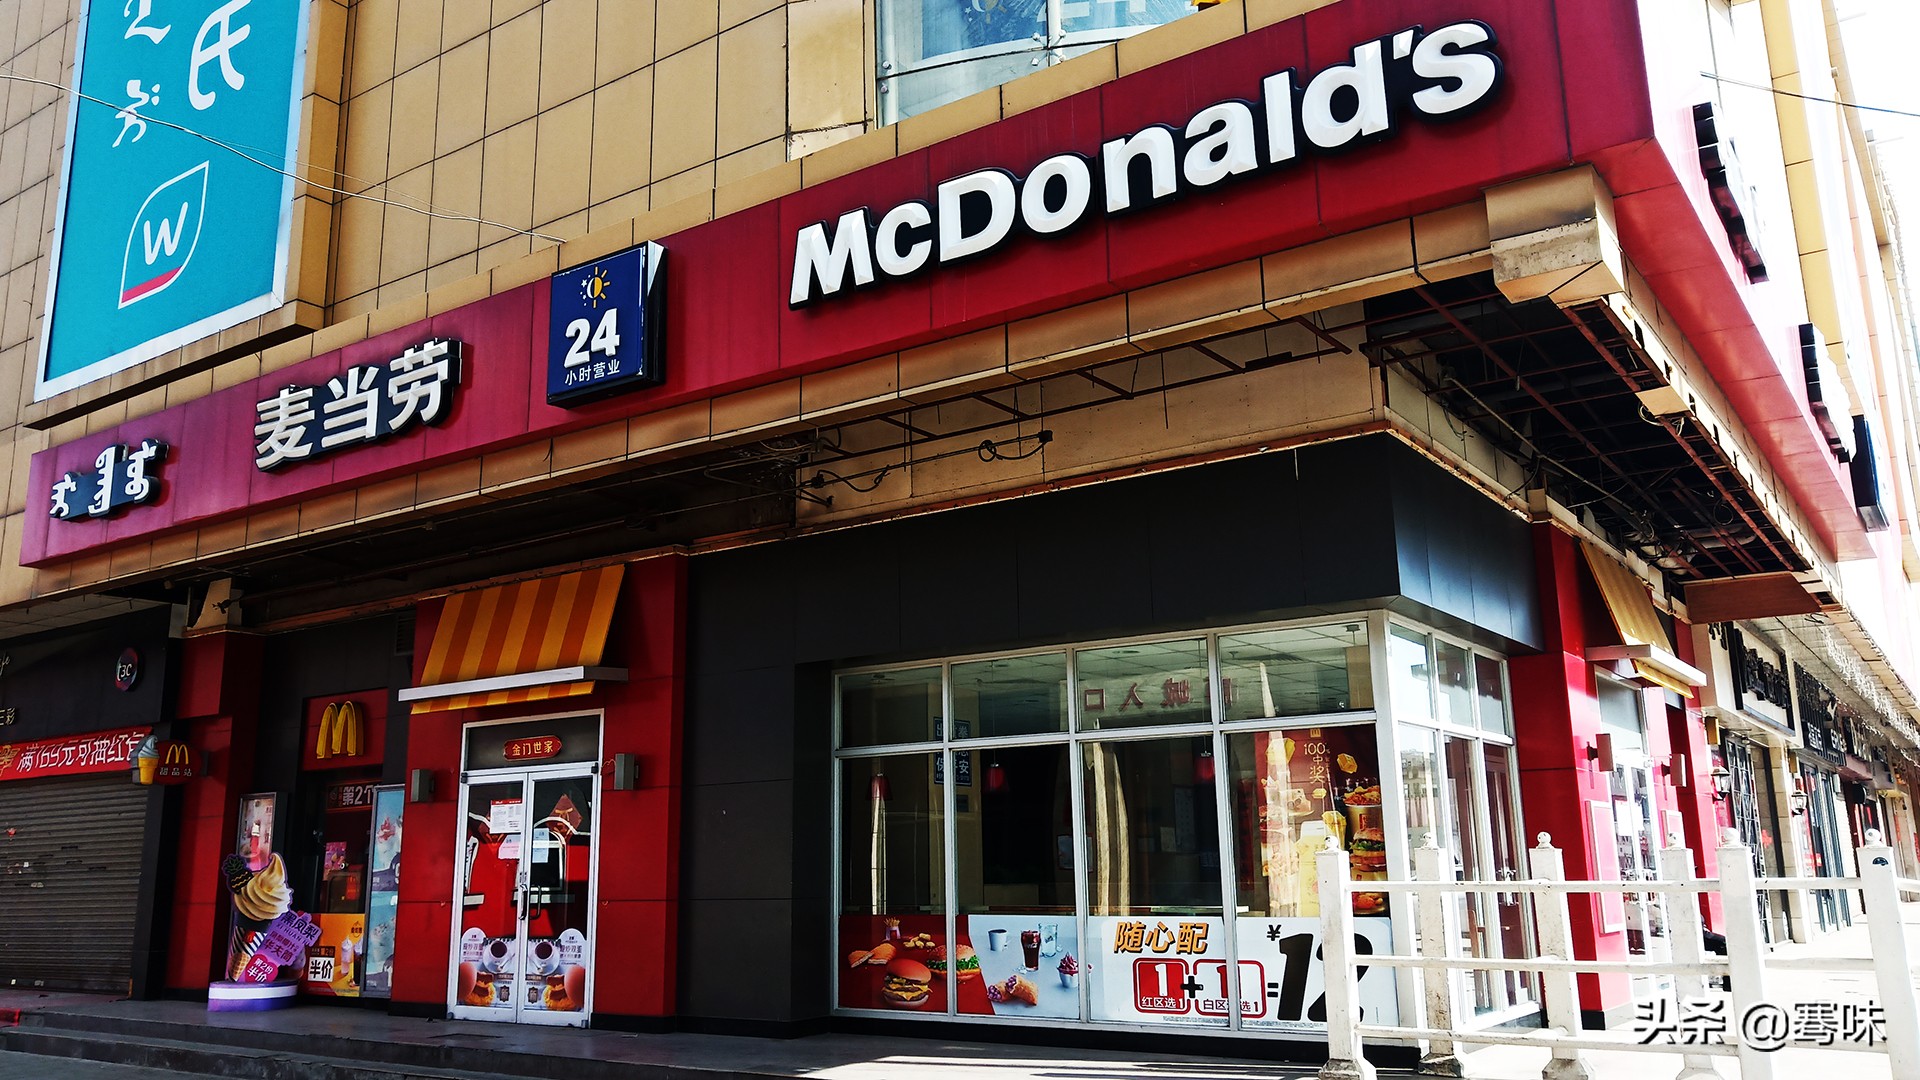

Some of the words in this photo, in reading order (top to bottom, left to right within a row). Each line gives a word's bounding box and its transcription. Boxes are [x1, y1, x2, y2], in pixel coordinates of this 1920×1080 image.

[790, 22, 1497, 306] McDonald's
[564, 308, 620, 368] 24
[565, 359, 620, 386] 小时营业
[255, 340, 450, 469] 麦当劳
[512, 740, 554, 757] 金门世家
[159, 767, 192, 778] 甜品站
[281, 911, 319, 940] 黑凤梨
[1114, 921, 1209, 955] 随心配
[247, 966, 268, 983] 半价
[310, 959, 333, 980] 半价
